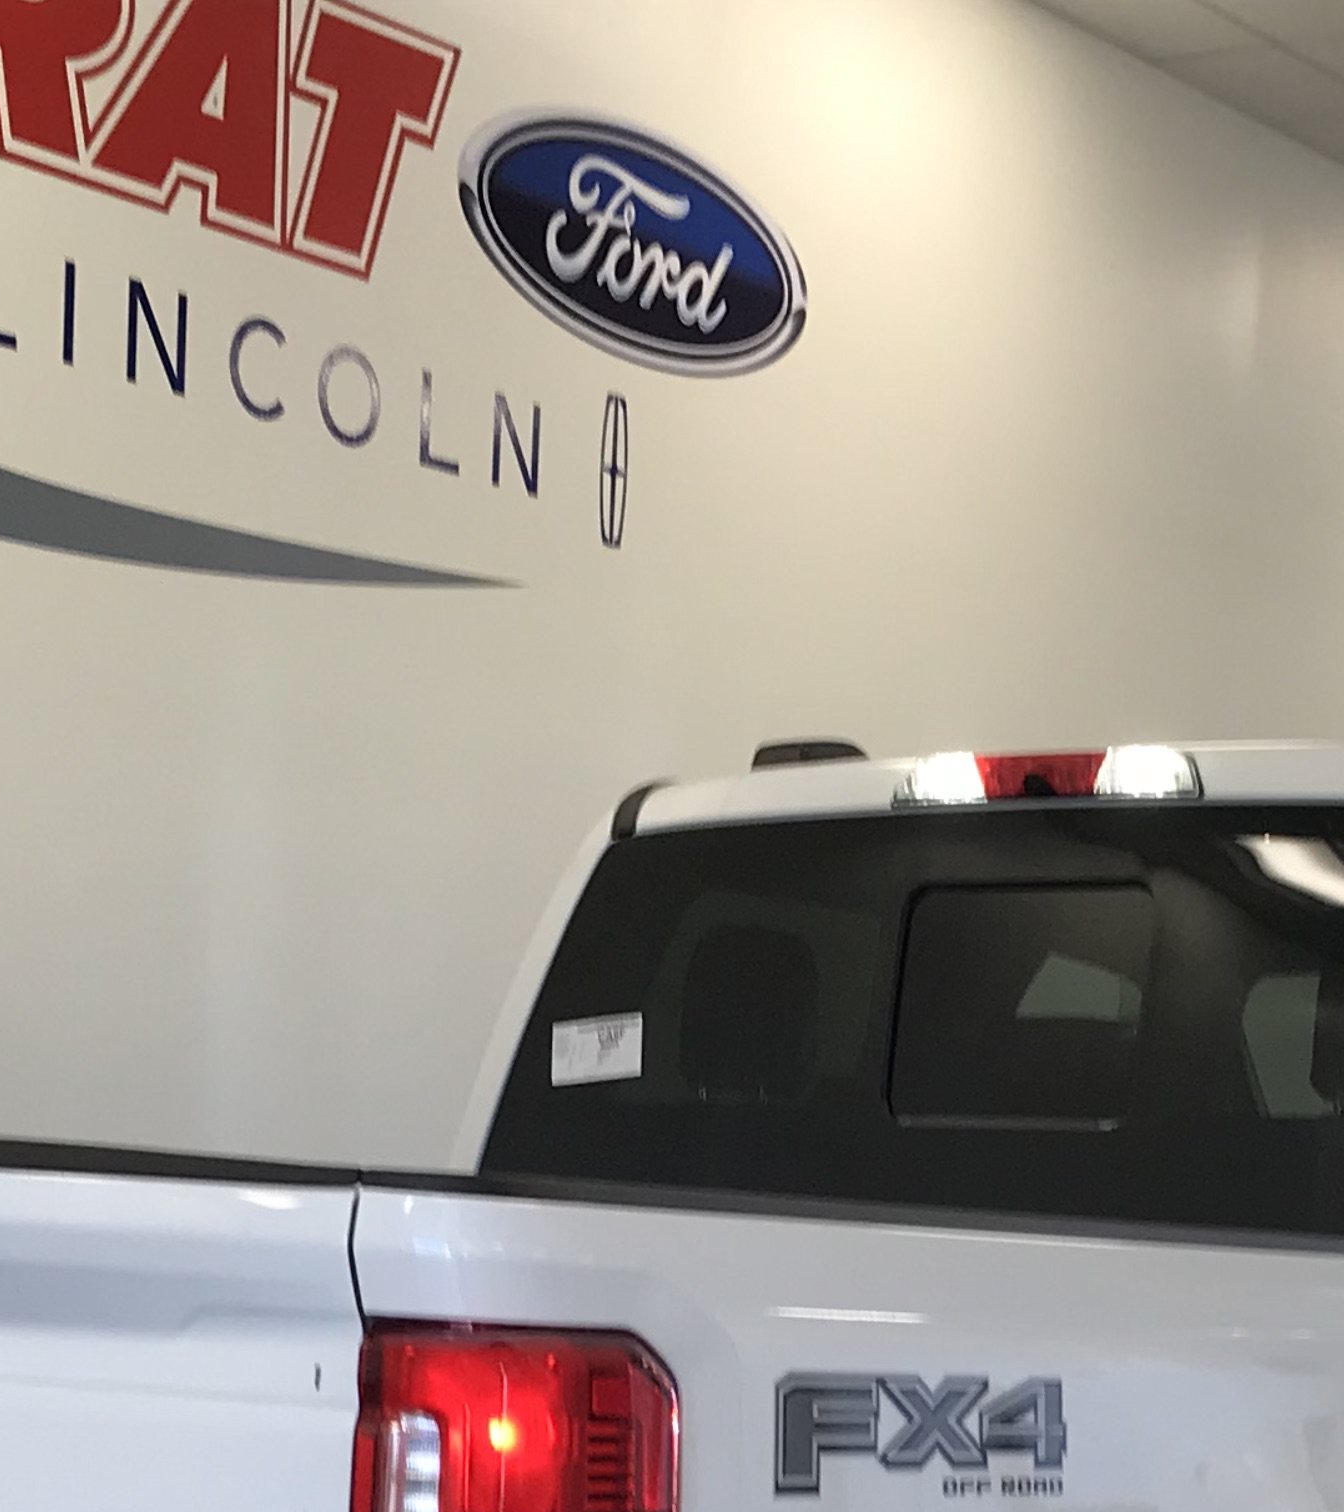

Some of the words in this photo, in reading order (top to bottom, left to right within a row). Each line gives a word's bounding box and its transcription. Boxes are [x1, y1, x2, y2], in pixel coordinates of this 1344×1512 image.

[545, 154, 734, 334] Ford
[773, 1370, 1068, 1495] FX4
[941, 1474, 992, 1498] OFF
[1000, 1474, 1065, 1498] ROAD
